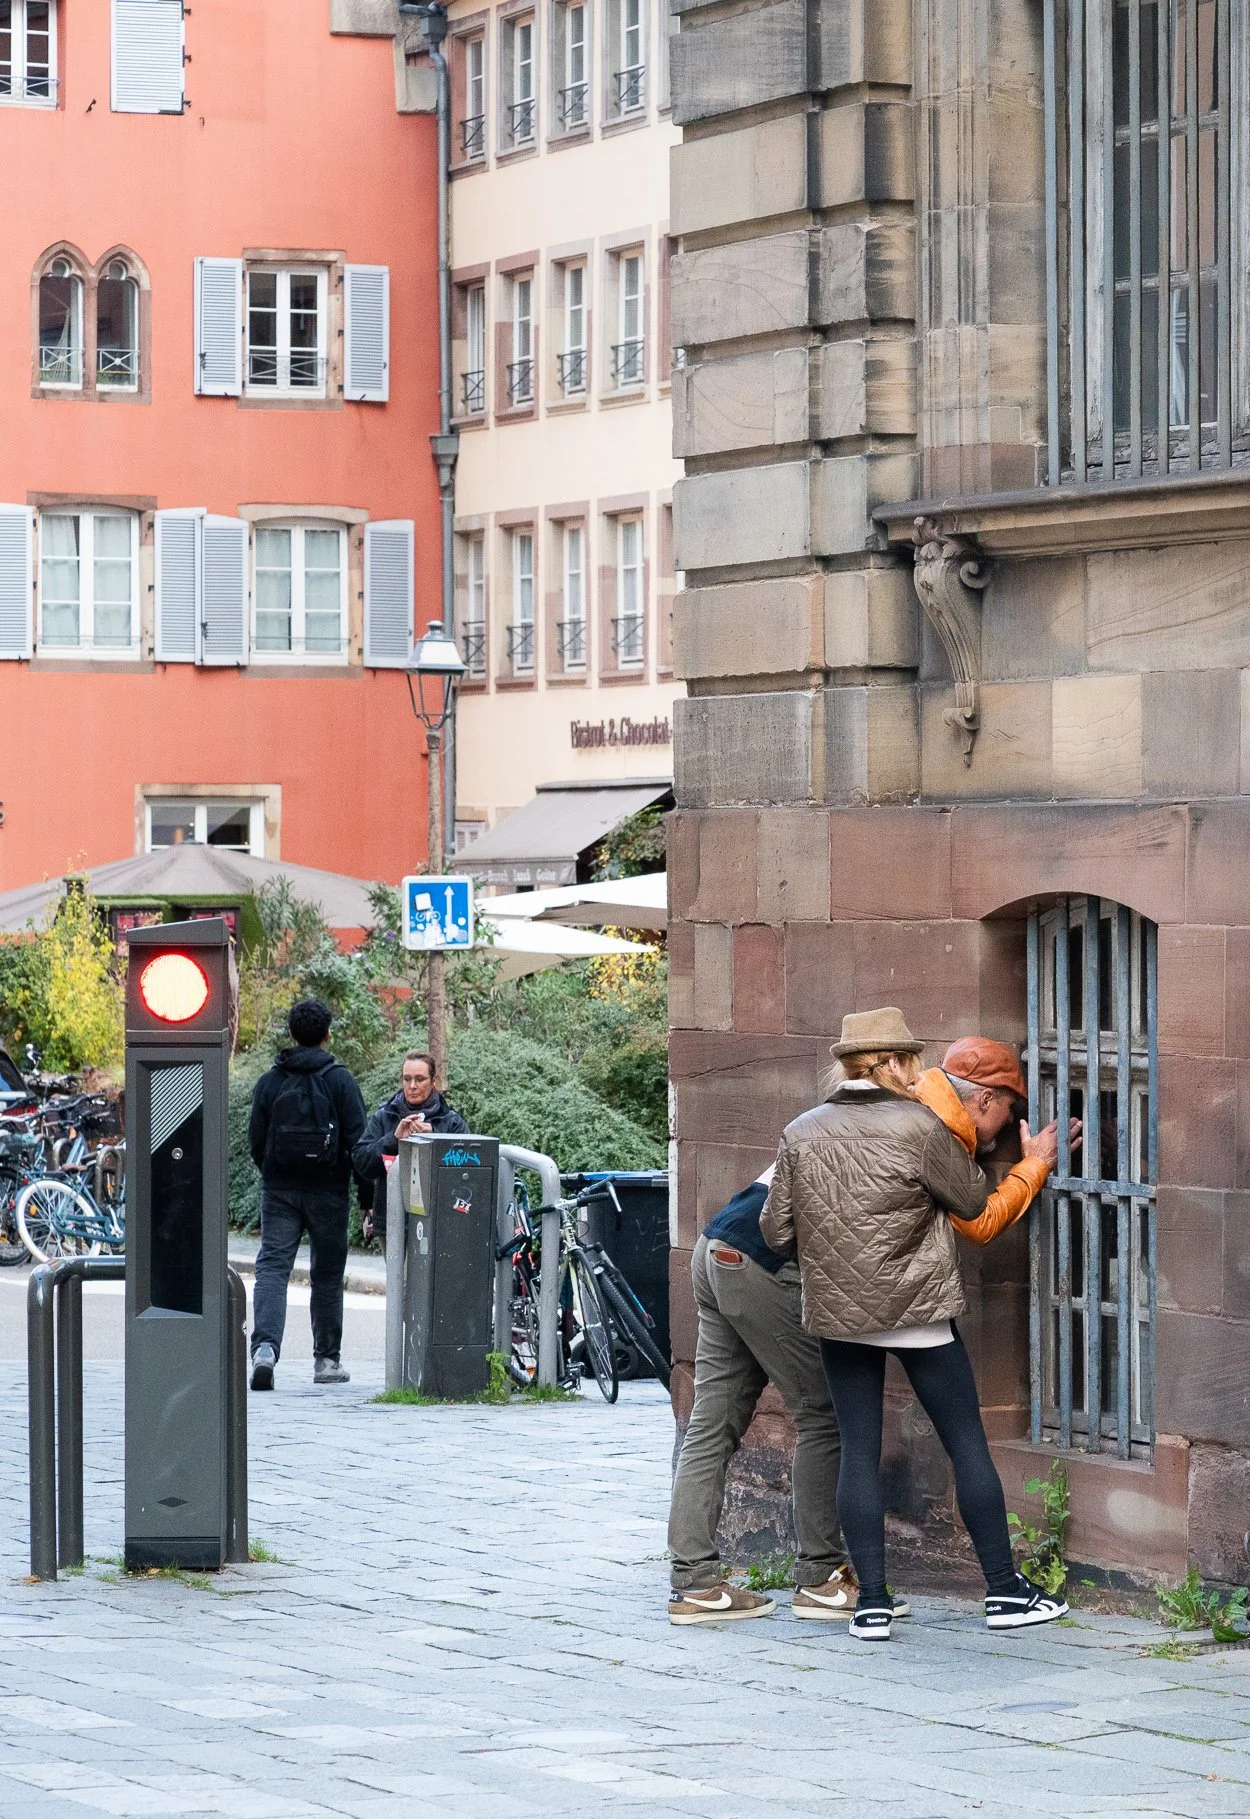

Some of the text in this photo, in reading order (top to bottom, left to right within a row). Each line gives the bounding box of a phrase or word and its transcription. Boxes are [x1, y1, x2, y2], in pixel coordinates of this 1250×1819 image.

[570, 716, 670, 748] Bistrot & Chocolat
